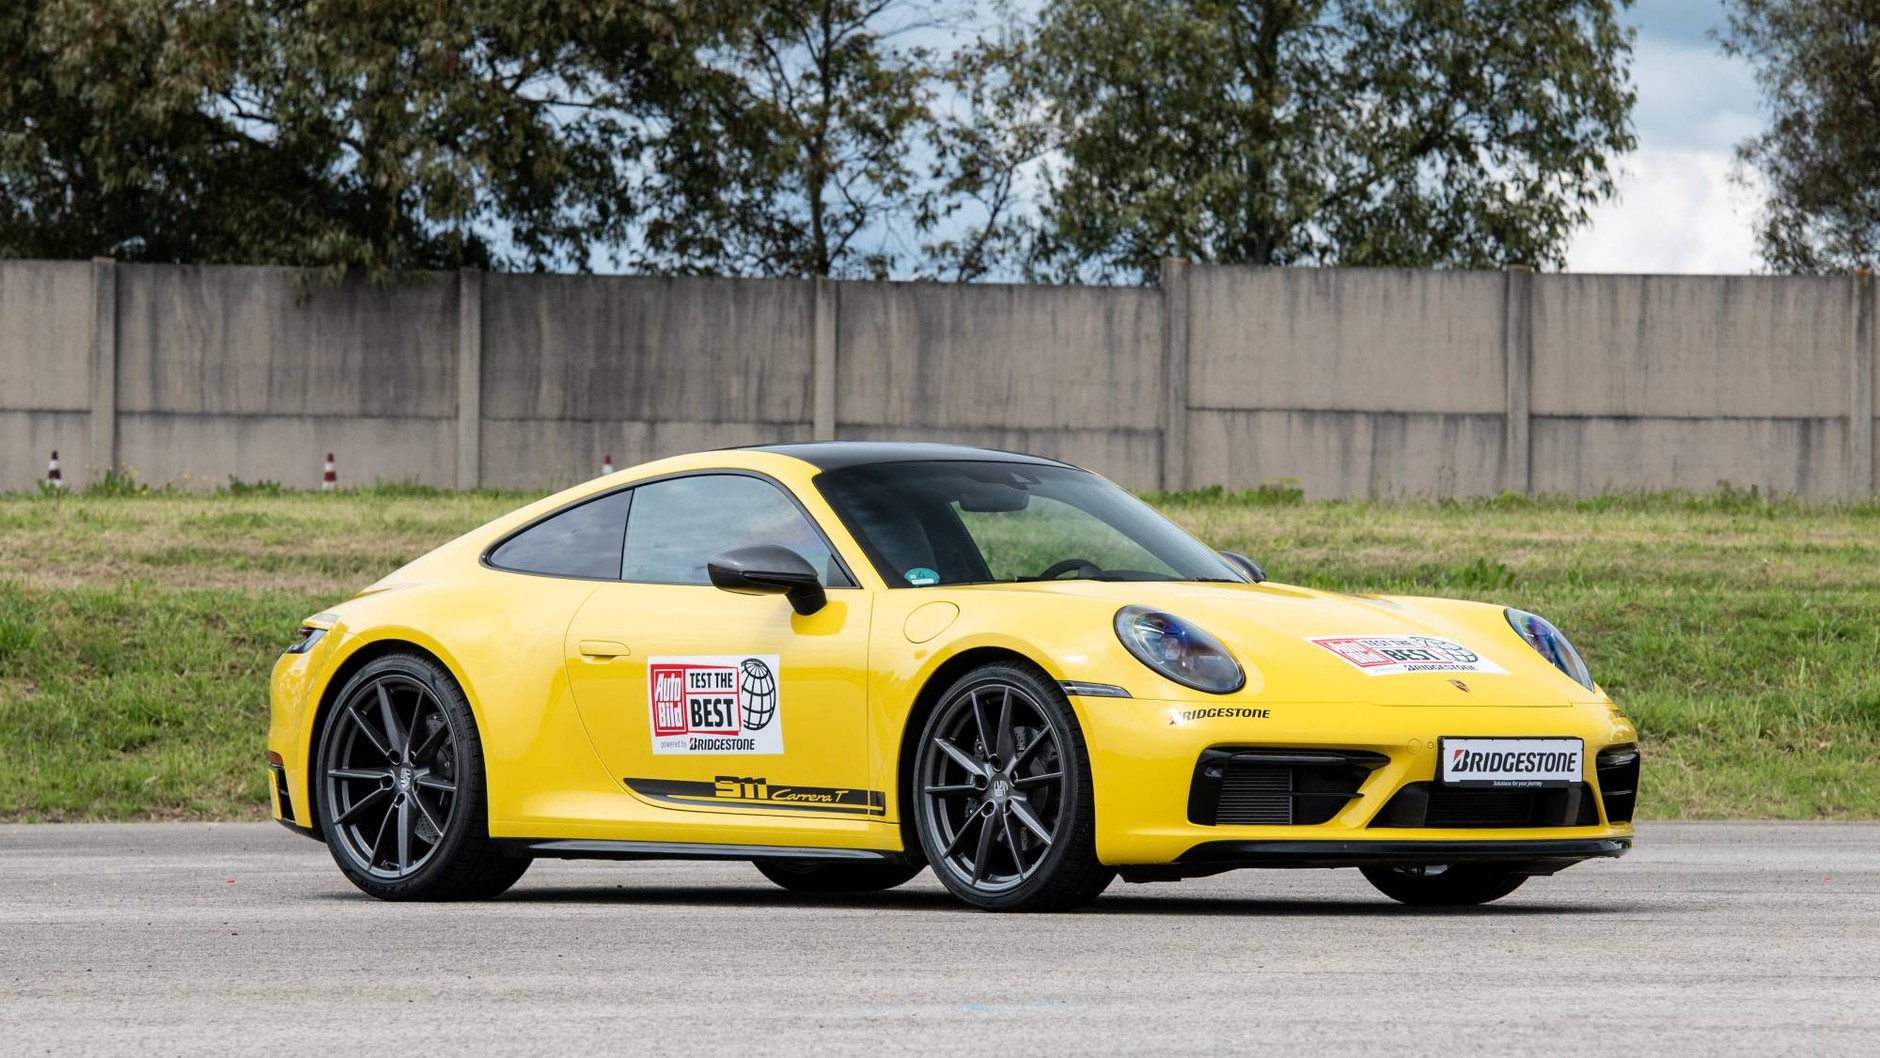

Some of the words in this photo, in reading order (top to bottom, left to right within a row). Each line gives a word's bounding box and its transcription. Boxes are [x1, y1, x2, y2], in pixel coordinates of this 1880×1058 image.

[1380, 649, 1441, 661] BEST
[655, 673, 682, 702] Auto
[690, 672, 712, 688] TEST
[714, 672, 733, 688] THE
[657, 701, 683, 728] Bild
[690, 698, 734, 728] BEST
[1169, 708, 1271, 725] RIDGESTONE
[661, 740, 679, 749] powered
[690, 737, 755, 750] BRIDGESTONE
[1451, 749, 1577, 773] BRIDGESTONE
[714, 776, 768, 799] 911
[771, 789, 833, 803] Carrera
[835, 790, 849, 803] T
